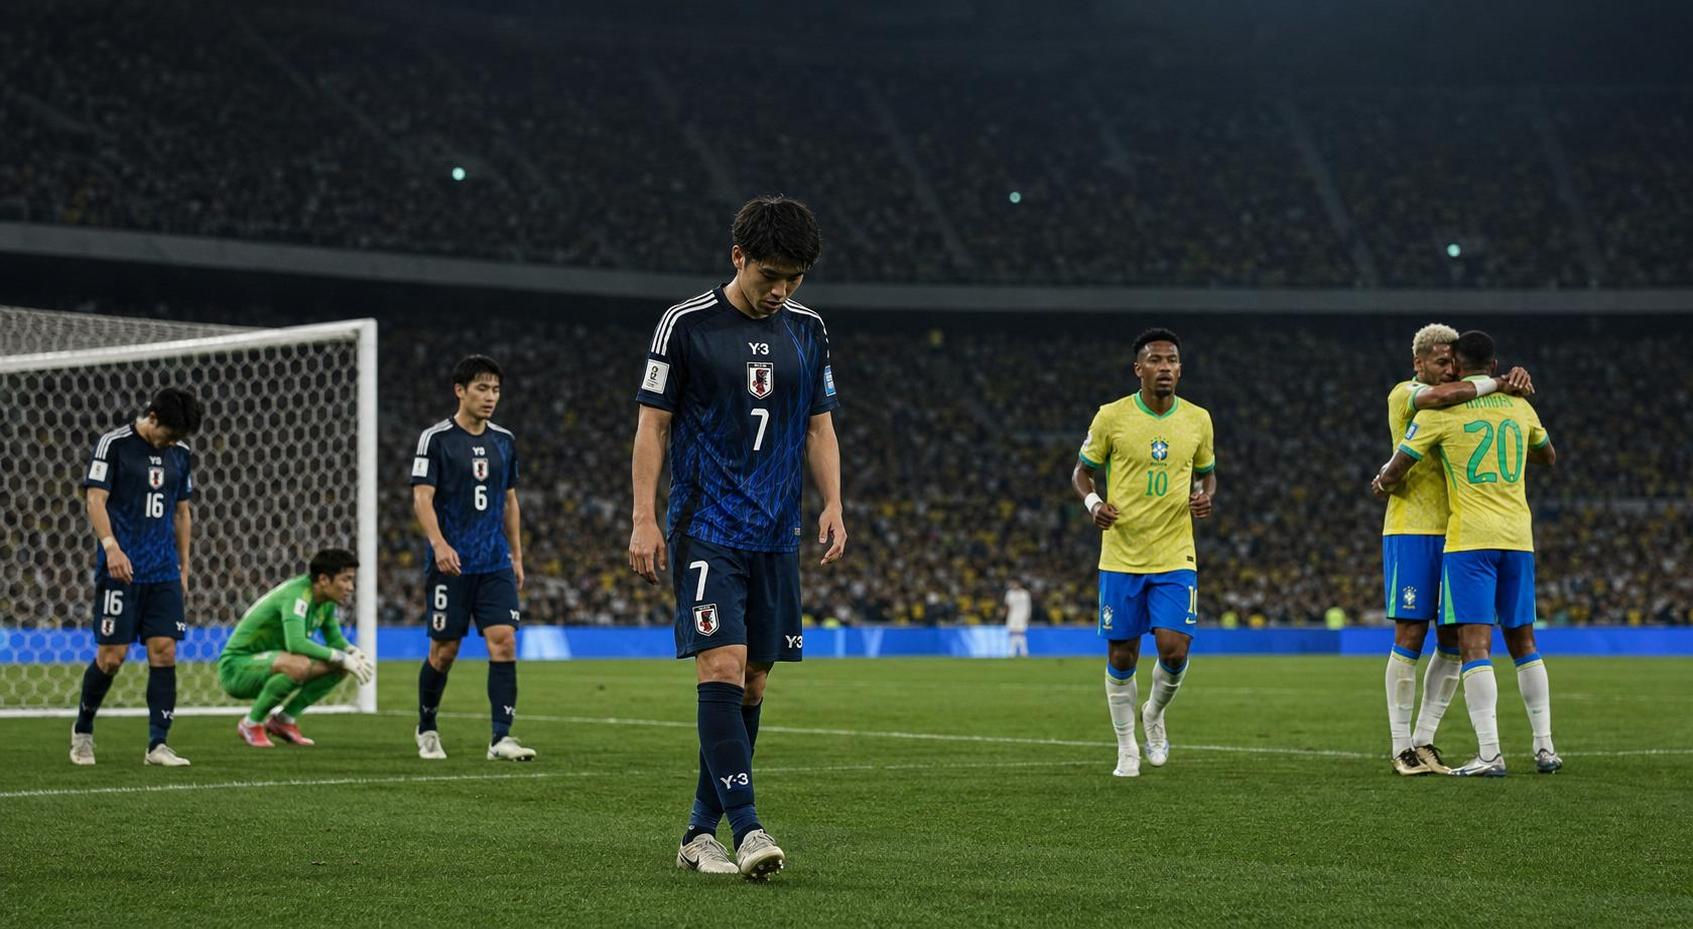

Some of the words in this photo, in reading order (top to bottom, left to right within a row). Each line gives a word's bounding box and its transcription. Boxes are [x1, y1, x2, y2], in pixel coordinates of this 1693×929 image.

[750, 408, 769, 451] 7
[1463, 418, 1523, 484] 20
[1145, 470, 1168, 497] 10
[145, 492, 164, 519] 16
[474, 485, 488, 511] 6
[689, 560, 709, 602] 7
[103, 589, 124, 616] 16
[434, 584, 448, 610] 6
